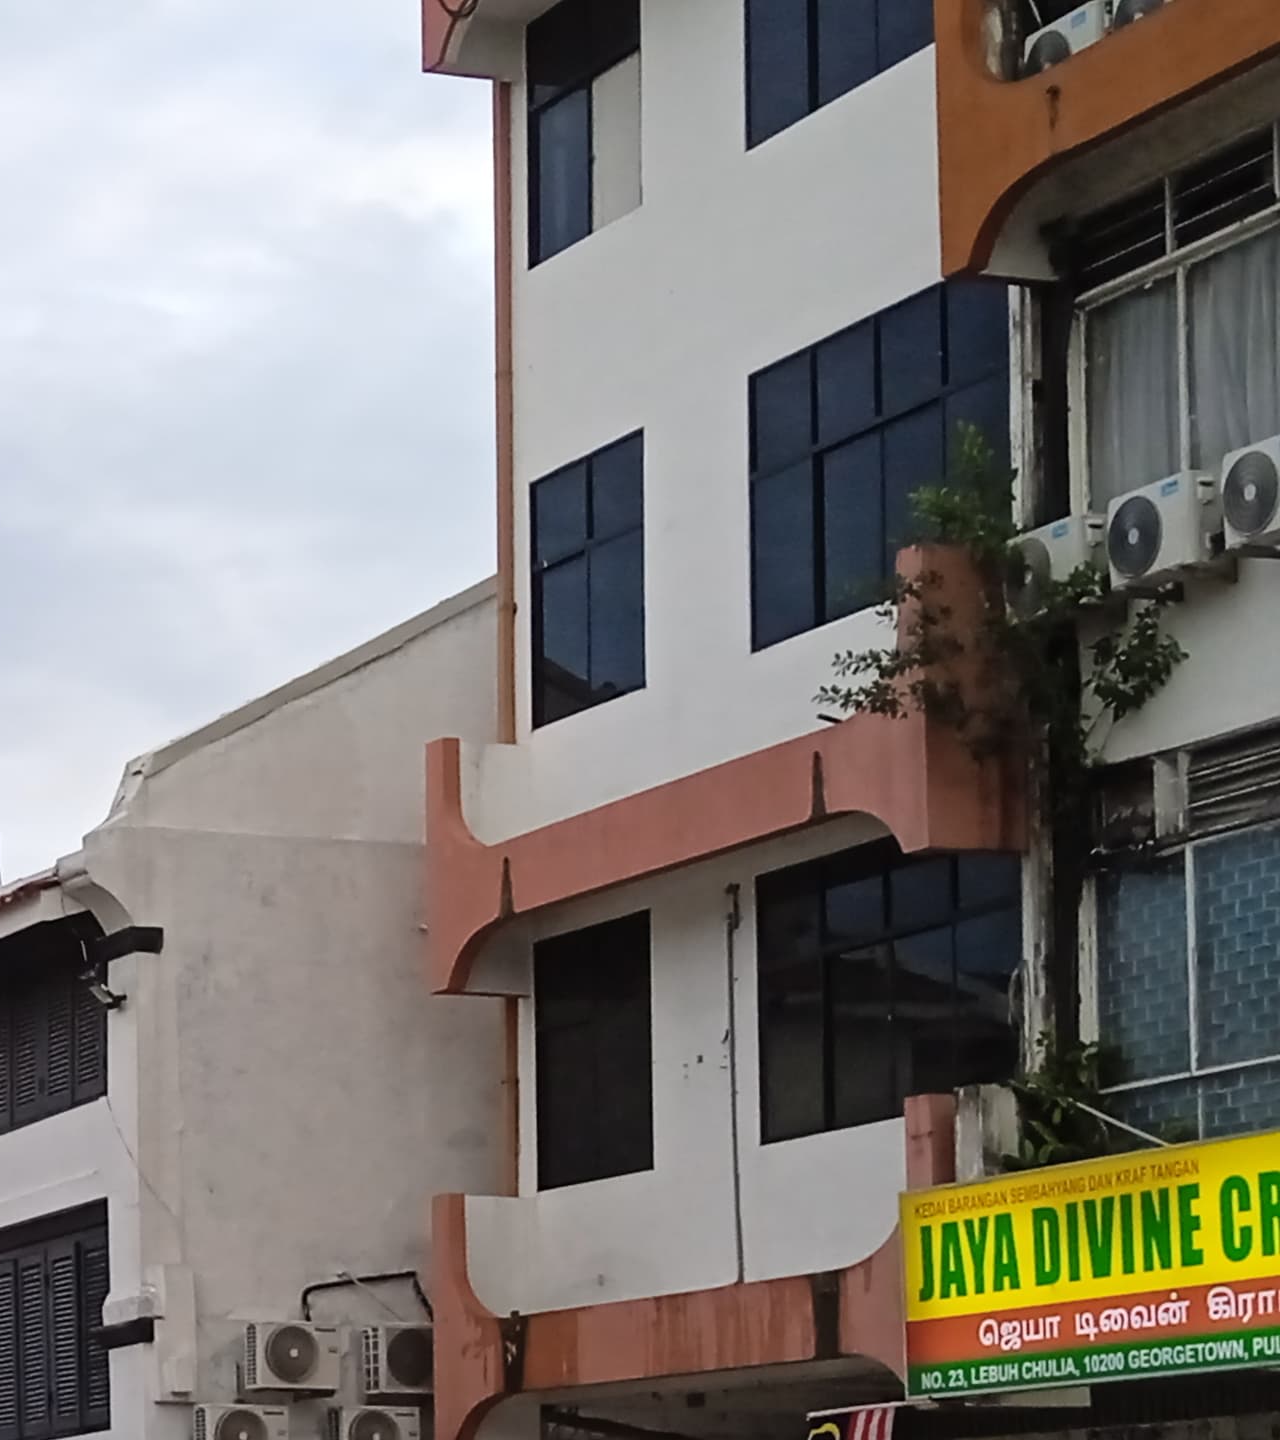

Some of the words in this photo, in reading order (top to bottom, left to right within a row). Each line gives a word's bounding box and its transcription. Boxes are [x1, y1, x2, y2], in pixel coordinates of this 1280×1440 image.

[949, 1189, 1008, 1213] BARANGAN
[1089, 1174, 1113, 1192] DAN
[1116, 1166, 1148, 1185] KRAF
[1150, 1159, 1200, 1180] TANGAN
[919, 1213, 1020, 1303] JAYA
[1032, 1183, 1204, 1287] DIVINE
[921, 1371, 946, 1389] NO.
[948, 1369, 968, 1388] 23,
[970, 1363, 1019, 1385] LEBUH
[1022, 1357, 1080, 1379] CHULIA,
[1083, 1352, 1125, 1373] 10200
[1128, 1339, 1249, 1368] GEORGETOWN,
